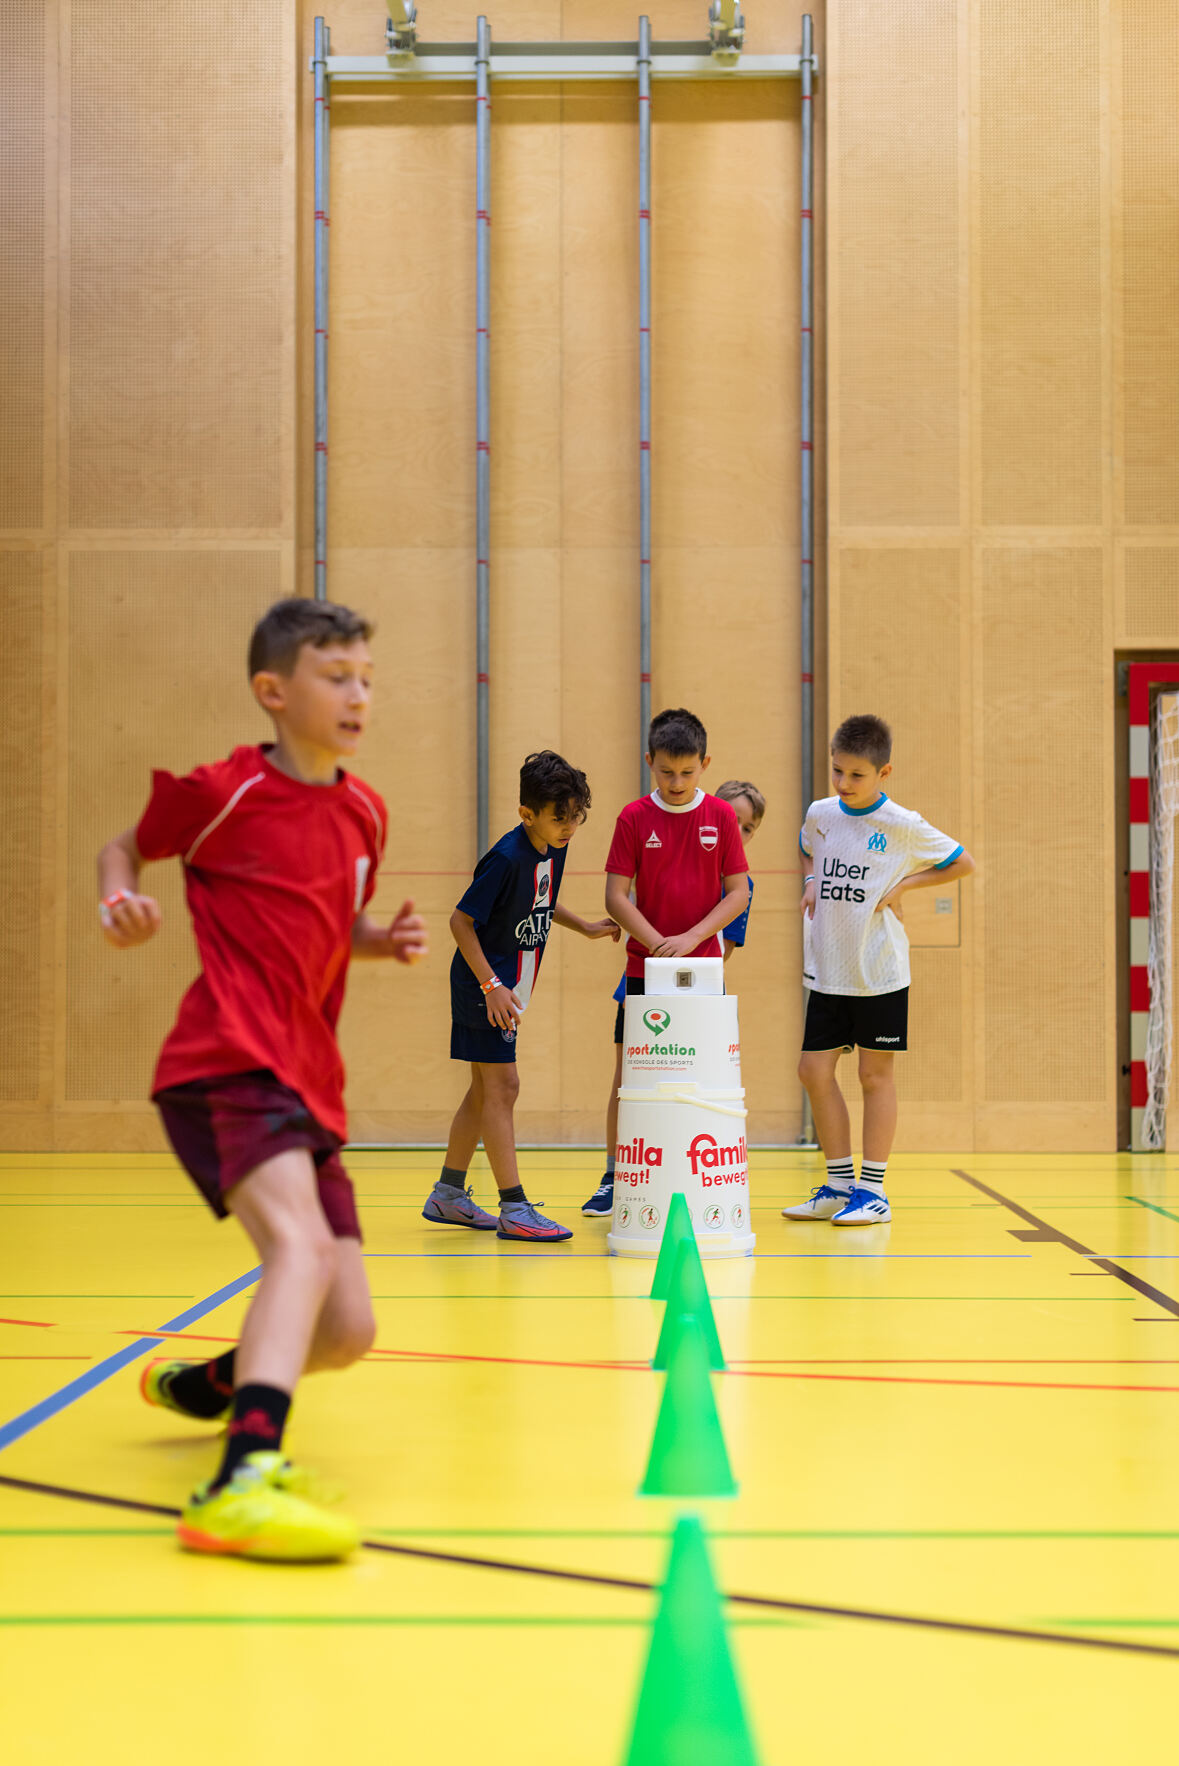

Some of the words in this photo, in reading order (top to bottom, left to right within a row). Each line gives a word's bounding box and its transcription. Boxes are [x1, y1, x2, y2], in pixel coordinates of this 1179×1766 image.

[823, 857, 870, 880] Uber
[820, 881, 866, 903] Eats
[627, 1043, 696, 1058] sportstation
[875, 1036, 900, 1044] uhlsport
[616, 1137, 662, 1167] mila
[686, 1133, 748, 1175] famil
[615, 1168, 650, 1187] wegt!
[701, 1168, 748, 1188] beweg
